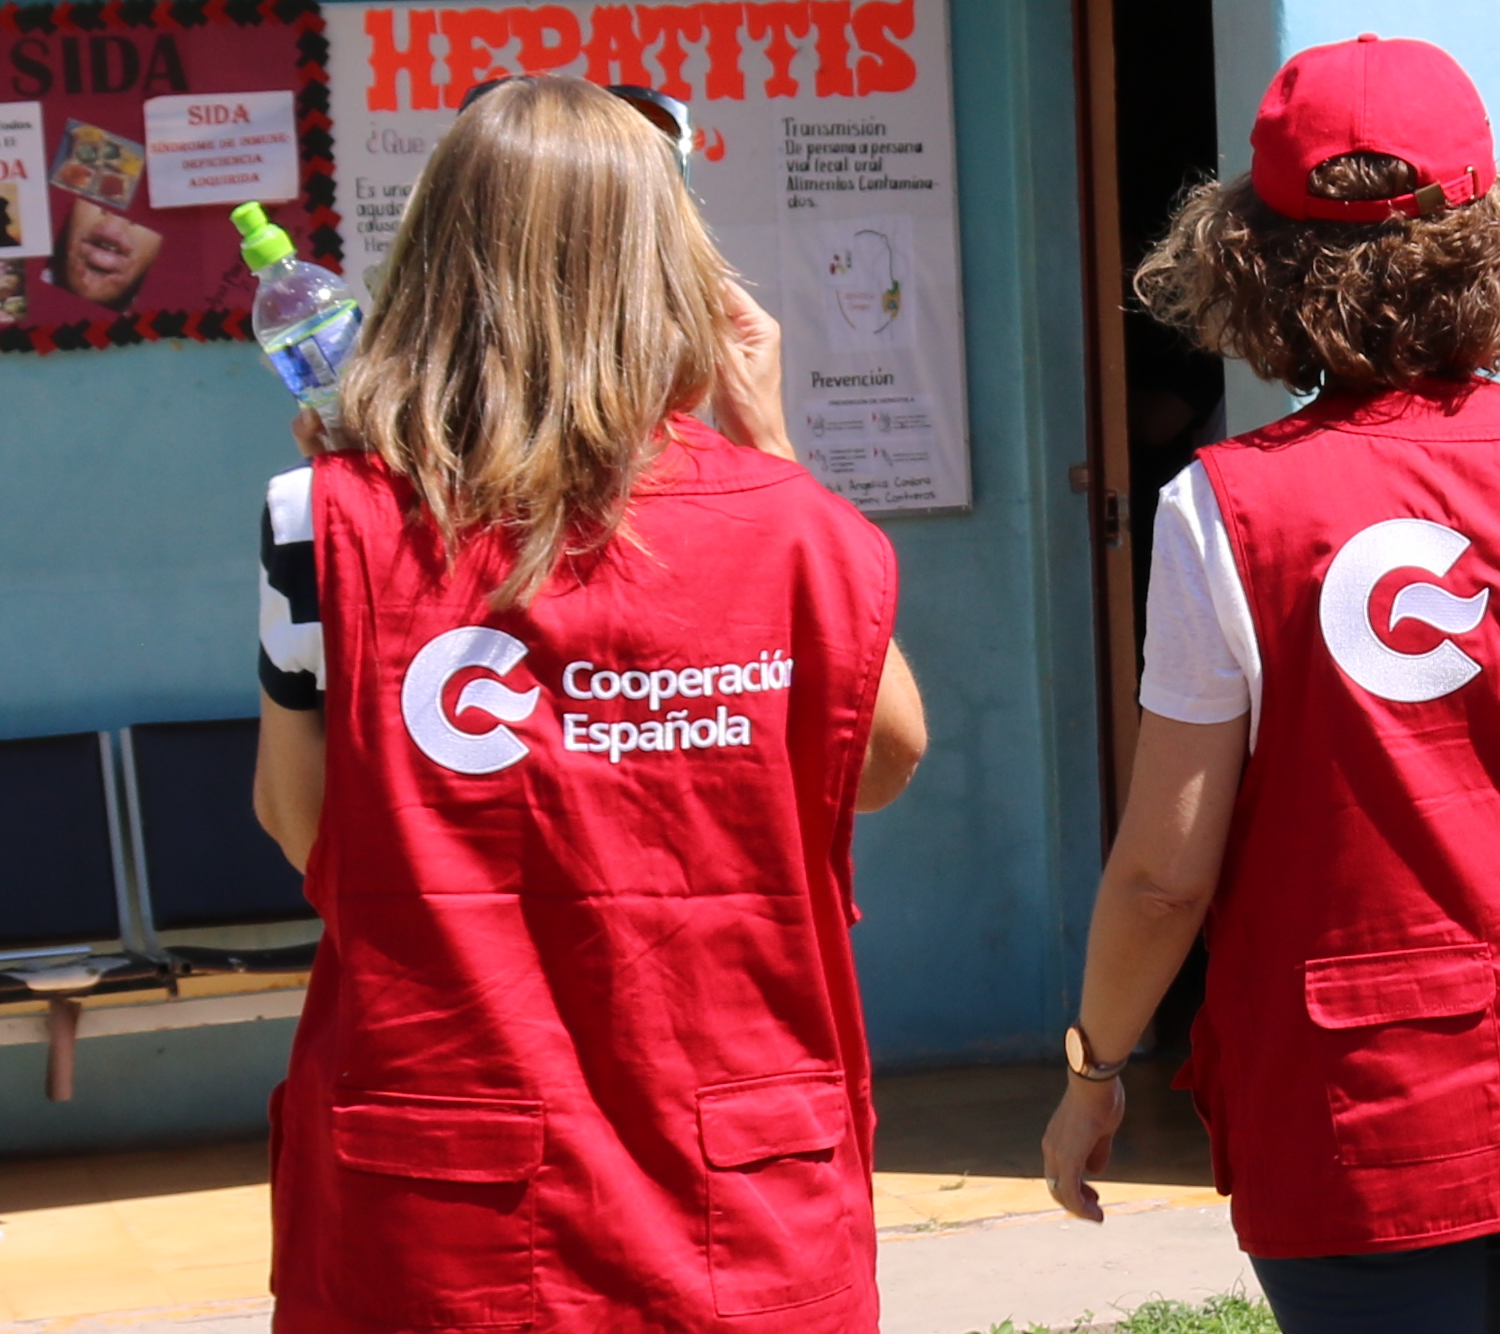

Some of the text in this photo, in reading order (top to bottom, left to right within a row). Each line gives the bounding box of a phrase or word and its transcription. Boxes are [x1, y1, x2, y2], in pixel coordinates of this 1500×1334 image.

[10, 34, 190, 98] SIDA
[188, 103, 251, 126] SIDA
[782, 116, 886, 137] Transmisión
[806, 142, 856, 160] persona
[871, 142, 923, 159] persona
[854, 157, 882, 173] oral
[356, 177, 375, 199] Es
[786, 175, 854, 191] Alimentos
[811, 368, 894, 388] Prevención
[562, 705, 751, 764] Española
